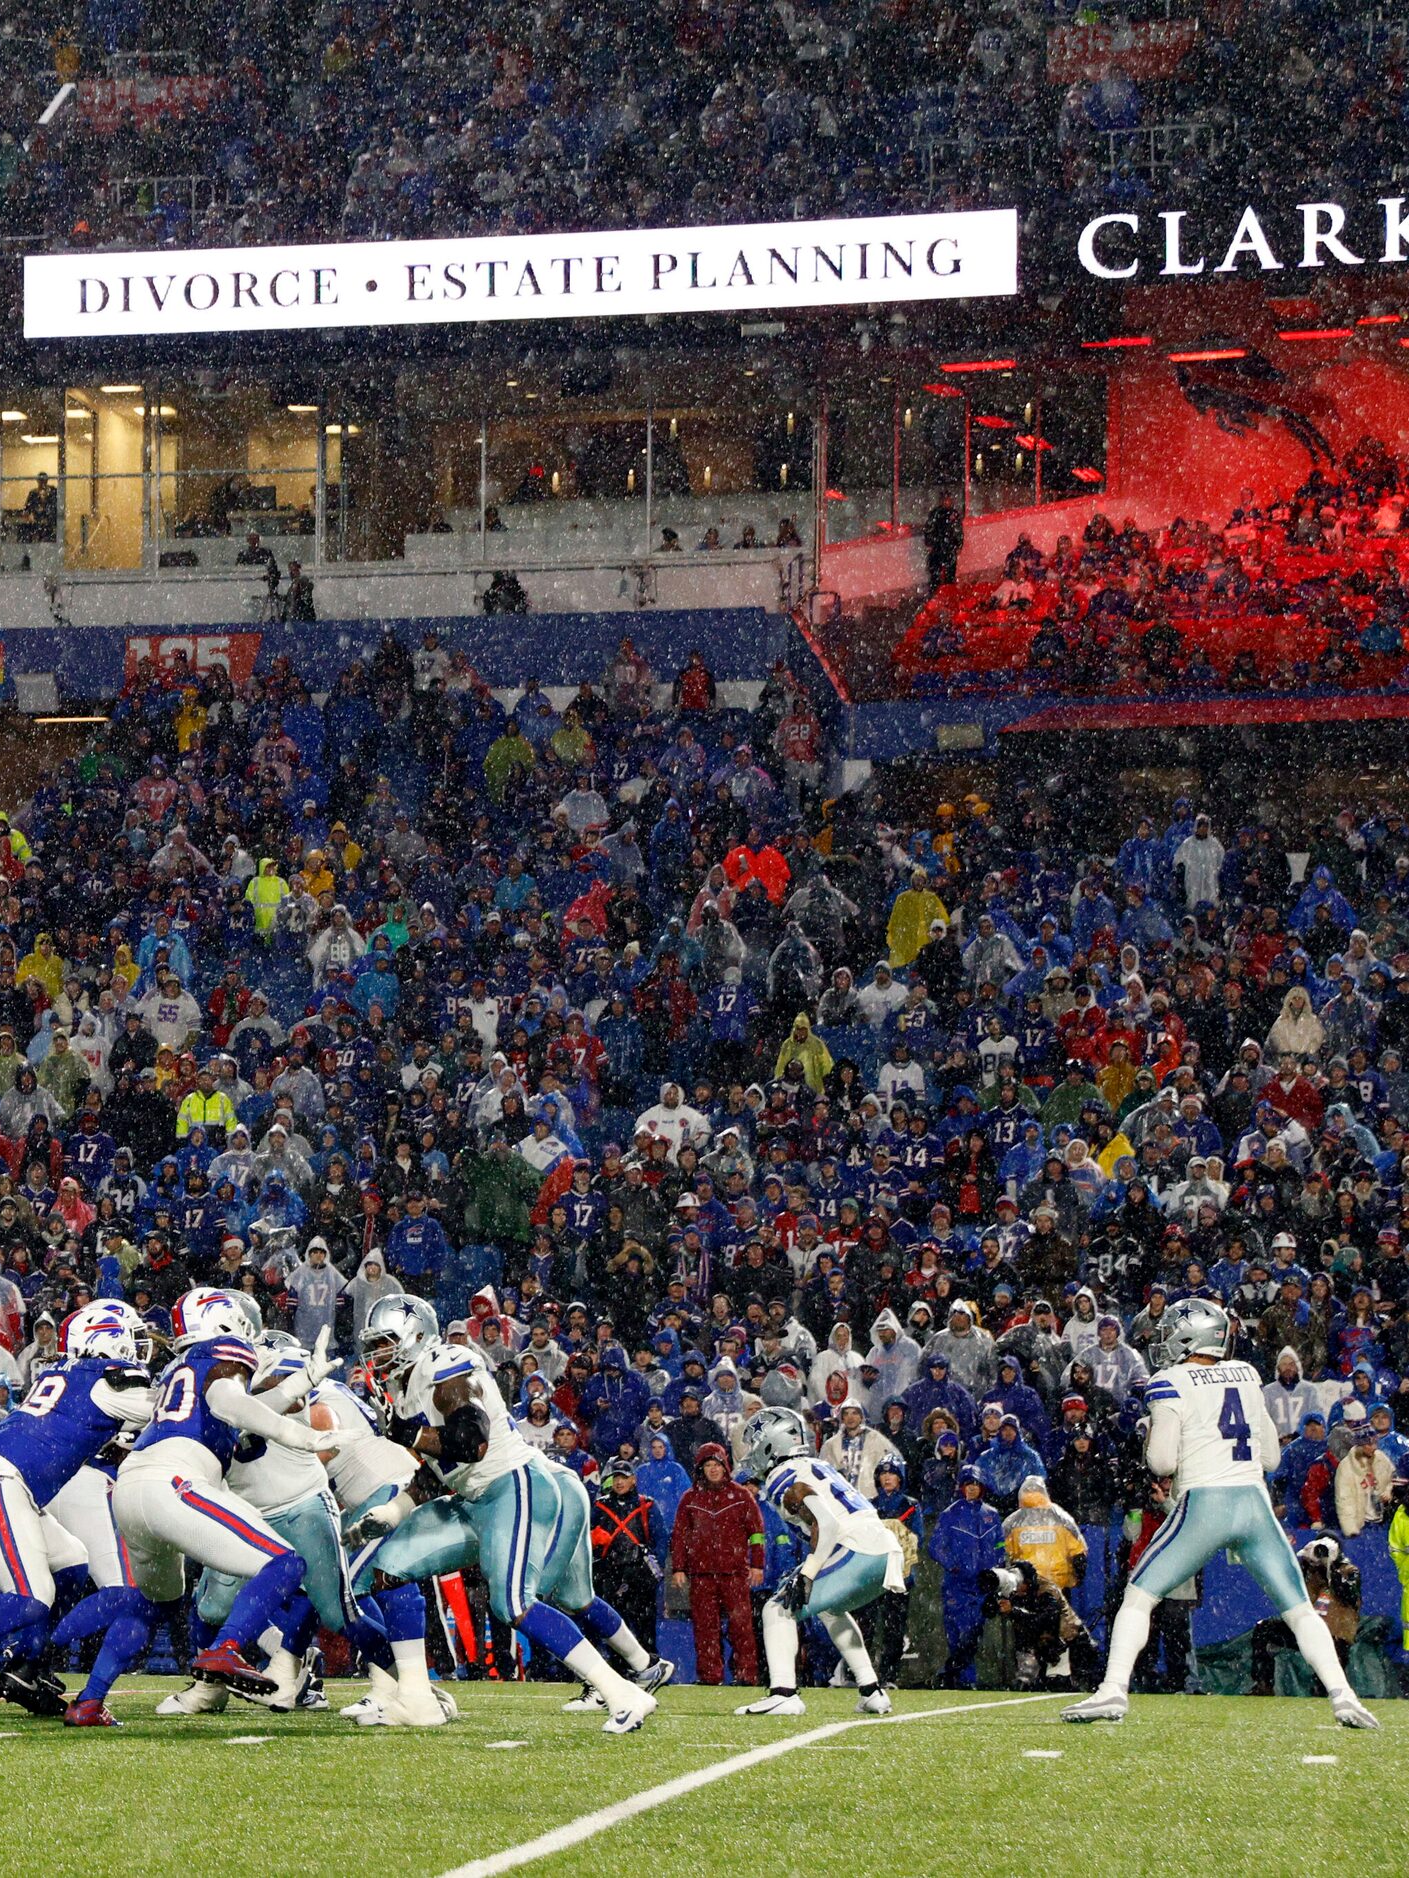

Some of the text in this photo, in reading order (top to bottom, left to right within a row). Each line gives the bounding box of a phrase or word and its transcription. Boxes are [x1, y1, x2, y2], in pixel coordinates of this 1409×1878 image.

[78, 236, 965, 313] DIVORCE ESTATE PLANNING
[789, 724, 810, 741] 28
[150, 786, 167, 801] 17
[159, 1003, 180, 1023] 55
[717, 994, 736, 1012] 17
[1024, 1028, 1044, 1047] 17
[456, 1082, 477, 1102] 17
[994, 1121, 1015, 1143] 13
[78, 1143, 99, 1164] 17
[904, 1147, 927, 1168] 14
[230, 1164, 250, 1186] 17
[573, 1204, 593, 1226] 17
[818, 1198, 837, 1216] 14
[184, 1208, 204, 1228] 17
[1097, 1254, 1127, 1276] 84
[309, 1283, 328, 1306] 17
[1094, 1364, 1119, 1388] 17
[1187, 1366, 1255, 1387] PRESCOTT
[150, 1365, 196, 1423] 0
[1274, 1396, 1304, 1428] 17
[1217, 1387, 1252, 1461] 4
